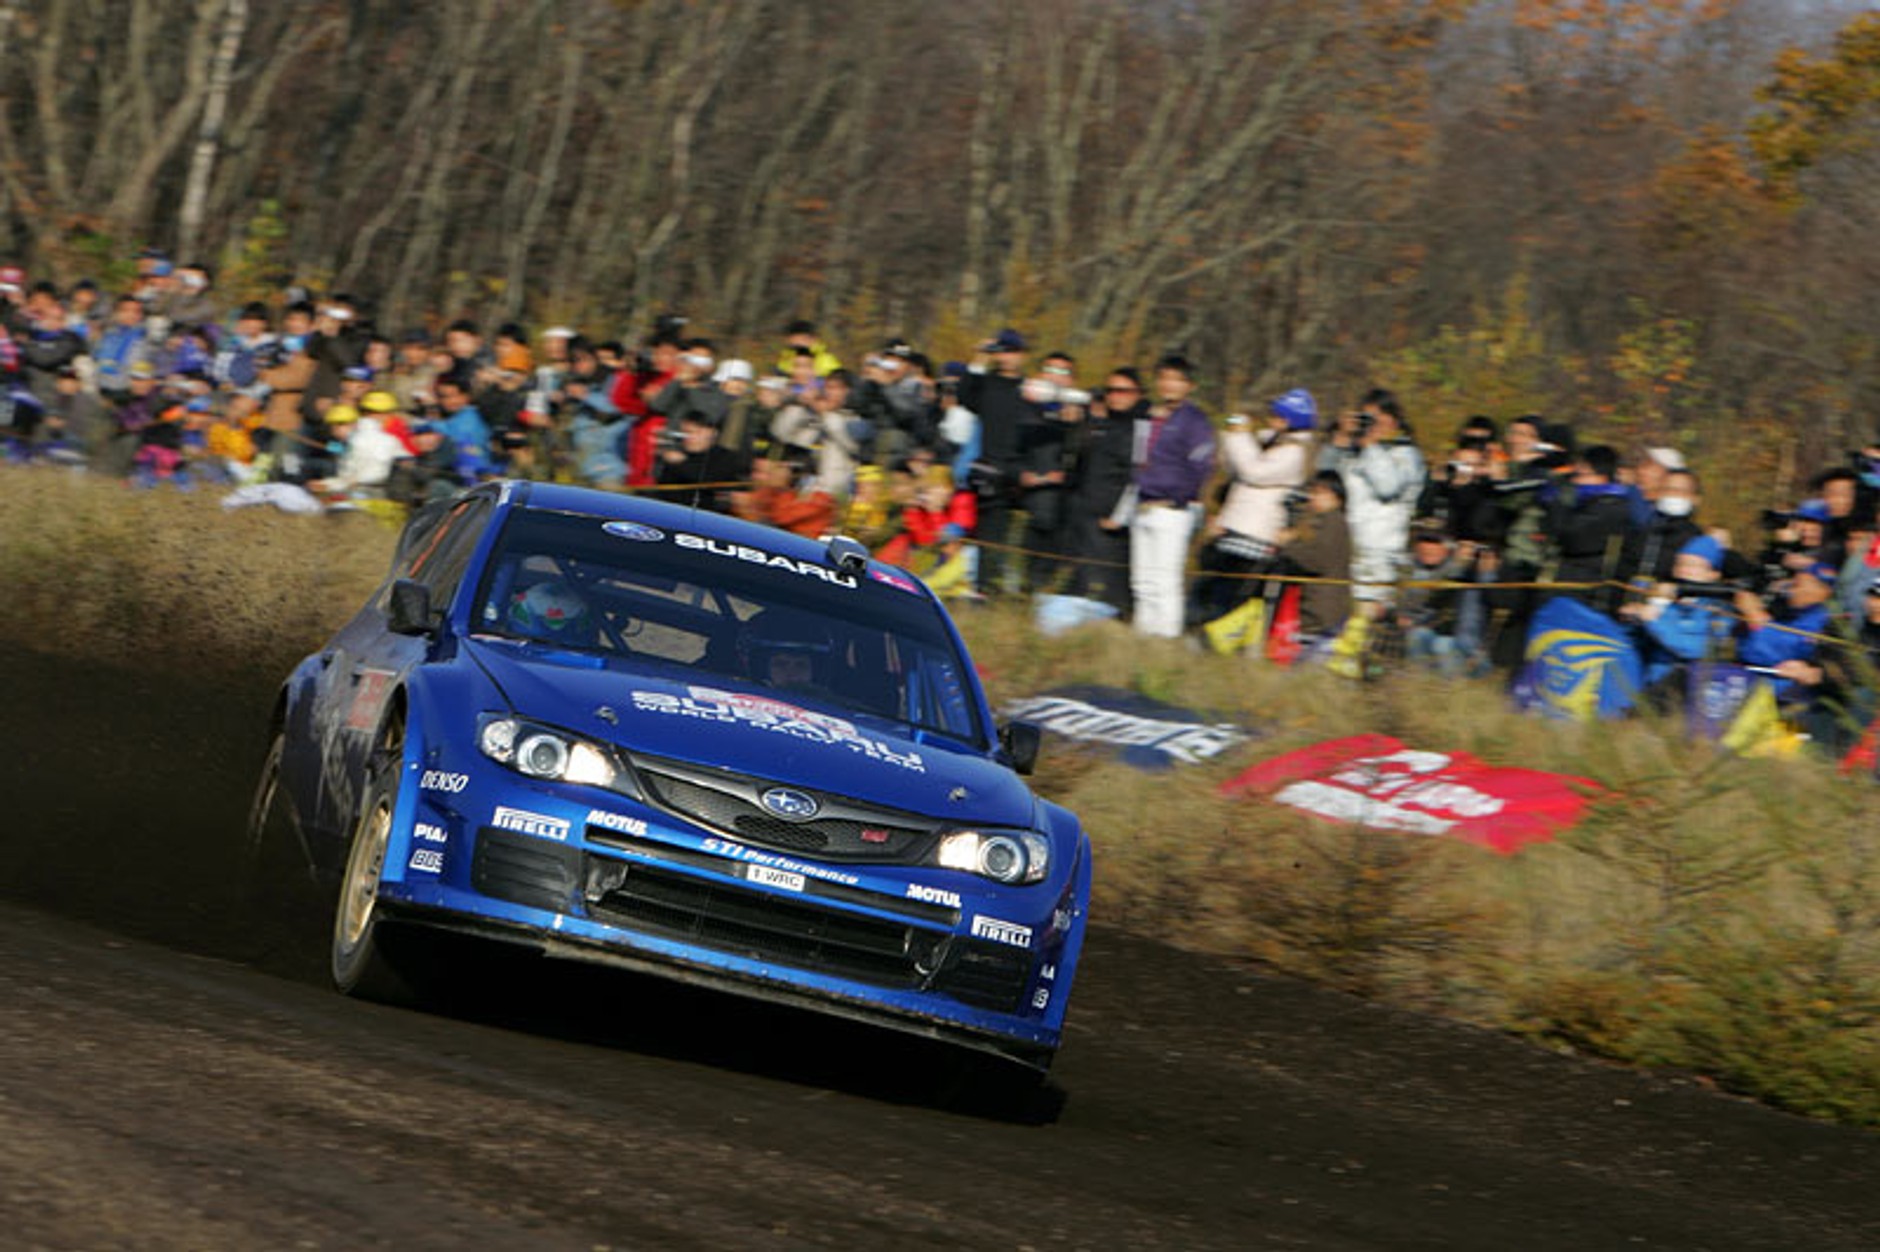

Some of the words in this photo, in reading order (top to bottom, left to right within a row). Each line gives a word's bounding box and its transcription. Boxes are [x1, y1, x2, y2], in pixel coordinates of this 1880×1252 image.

[674, 533, 858, 589] SUBARU
[420, 770, 470, 793] DENSO
[491, 806, 571, 841] PIRELLI
[702, 838, 744, 856] STI
[744, 851, 859, 885] Performance
[906, 883, 962, 909] MOTUL
[970, 914, 1033, 948] PIRELLI
